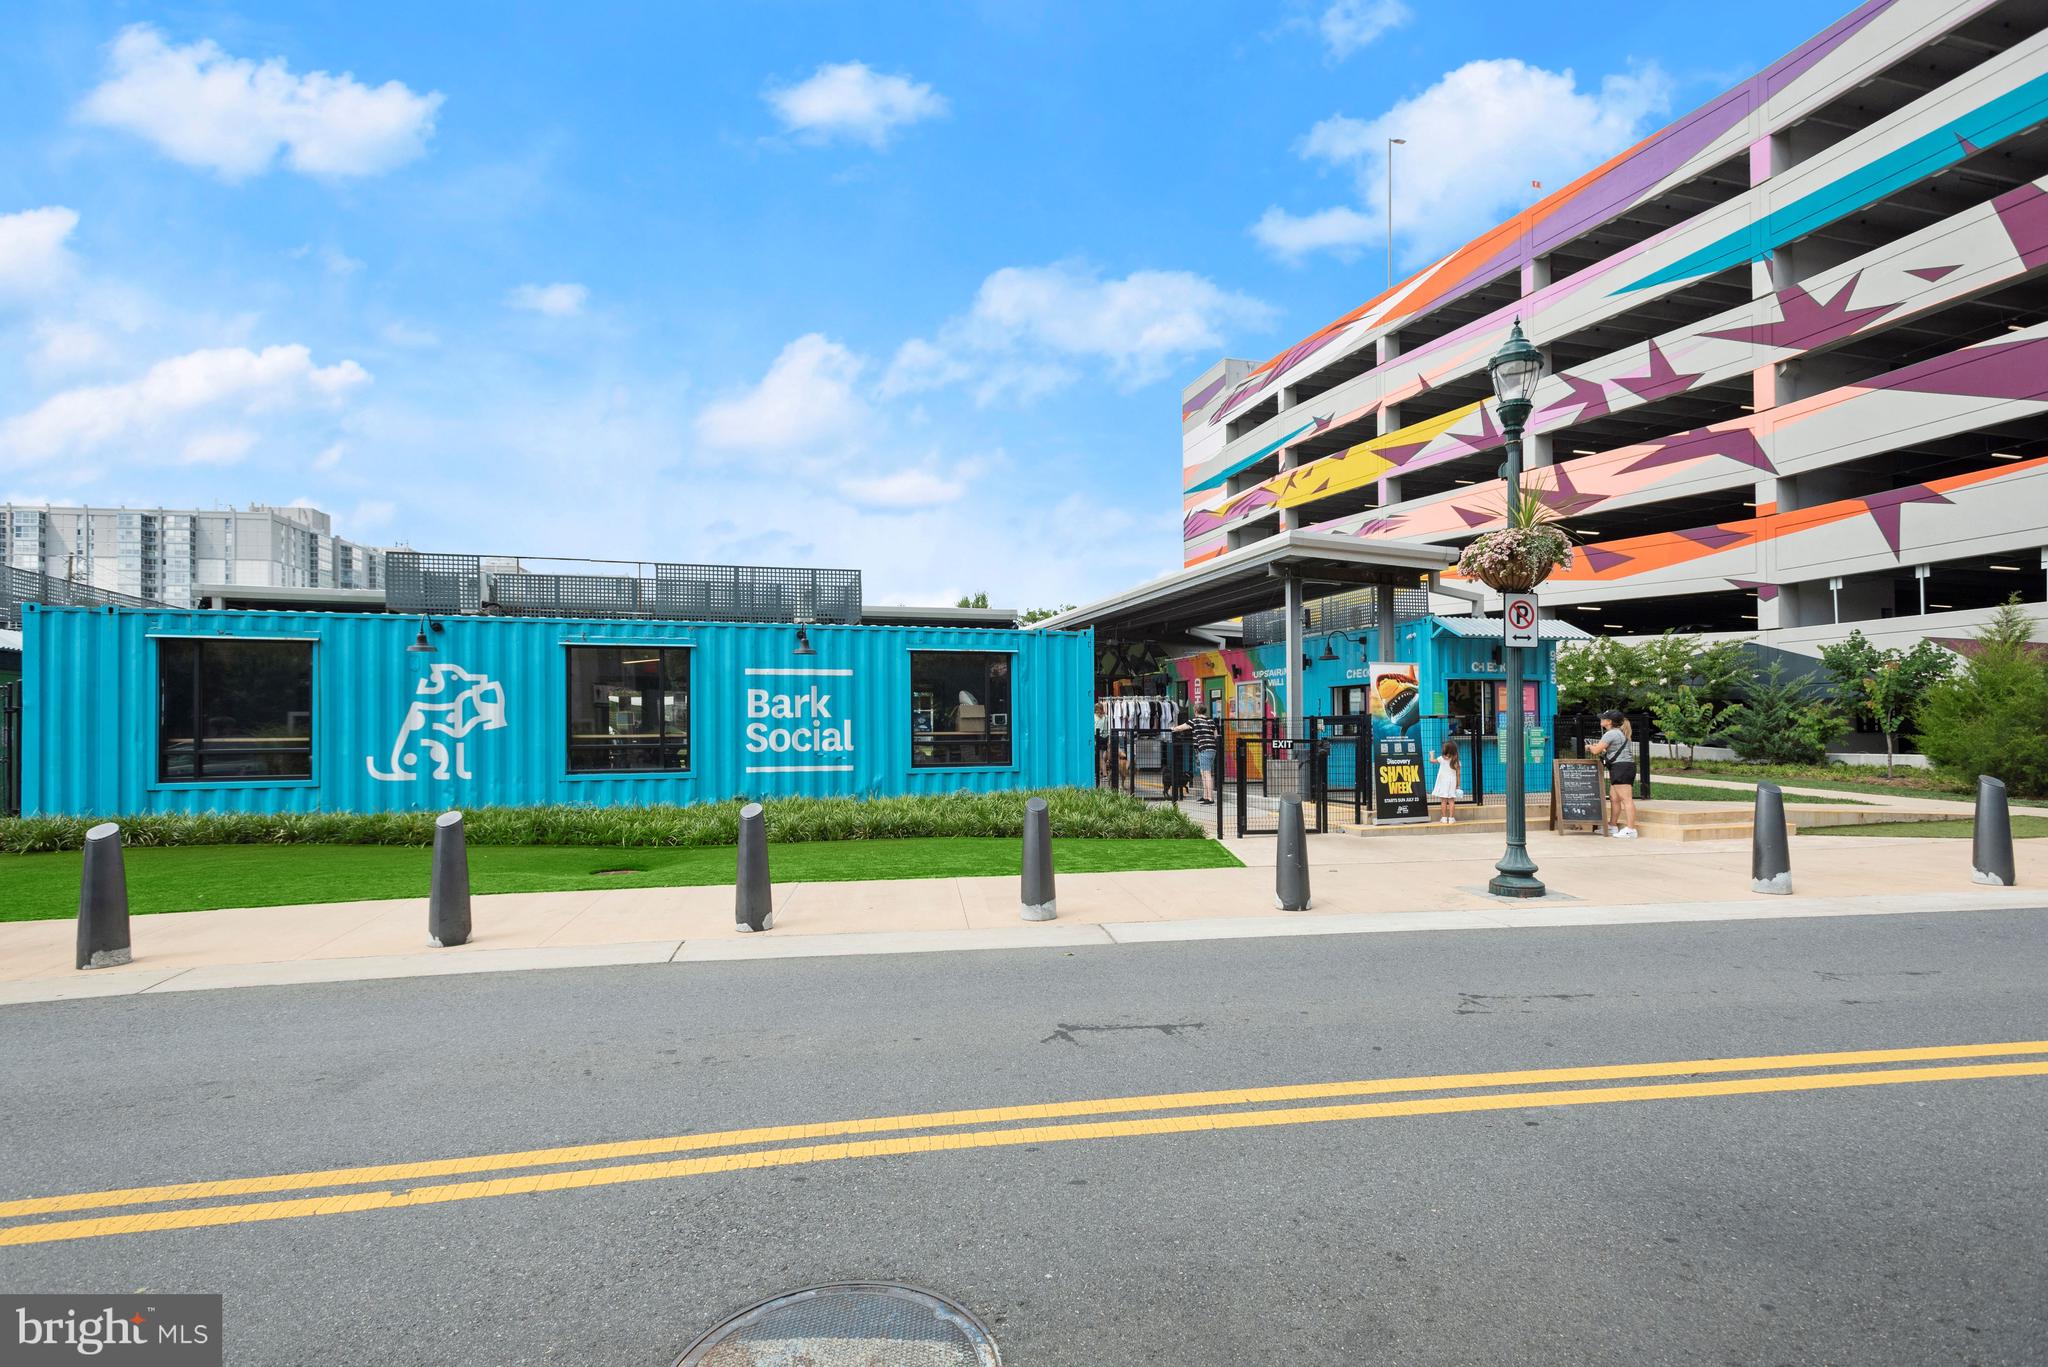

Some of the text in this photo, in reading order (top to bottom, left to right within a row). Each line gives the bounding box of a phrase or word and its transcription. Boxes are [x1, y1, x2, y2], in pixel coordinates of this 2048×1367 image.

[1516, 605, 1529, 625] P
[747, 685, 832, 719] Bark
[745, 719, 854, 752] Social
[1272, 740, 1293, 749] EXIT
[1379, 765, 1420, 783] SHARK
[1388, 782, 1413, 794] WEEK
